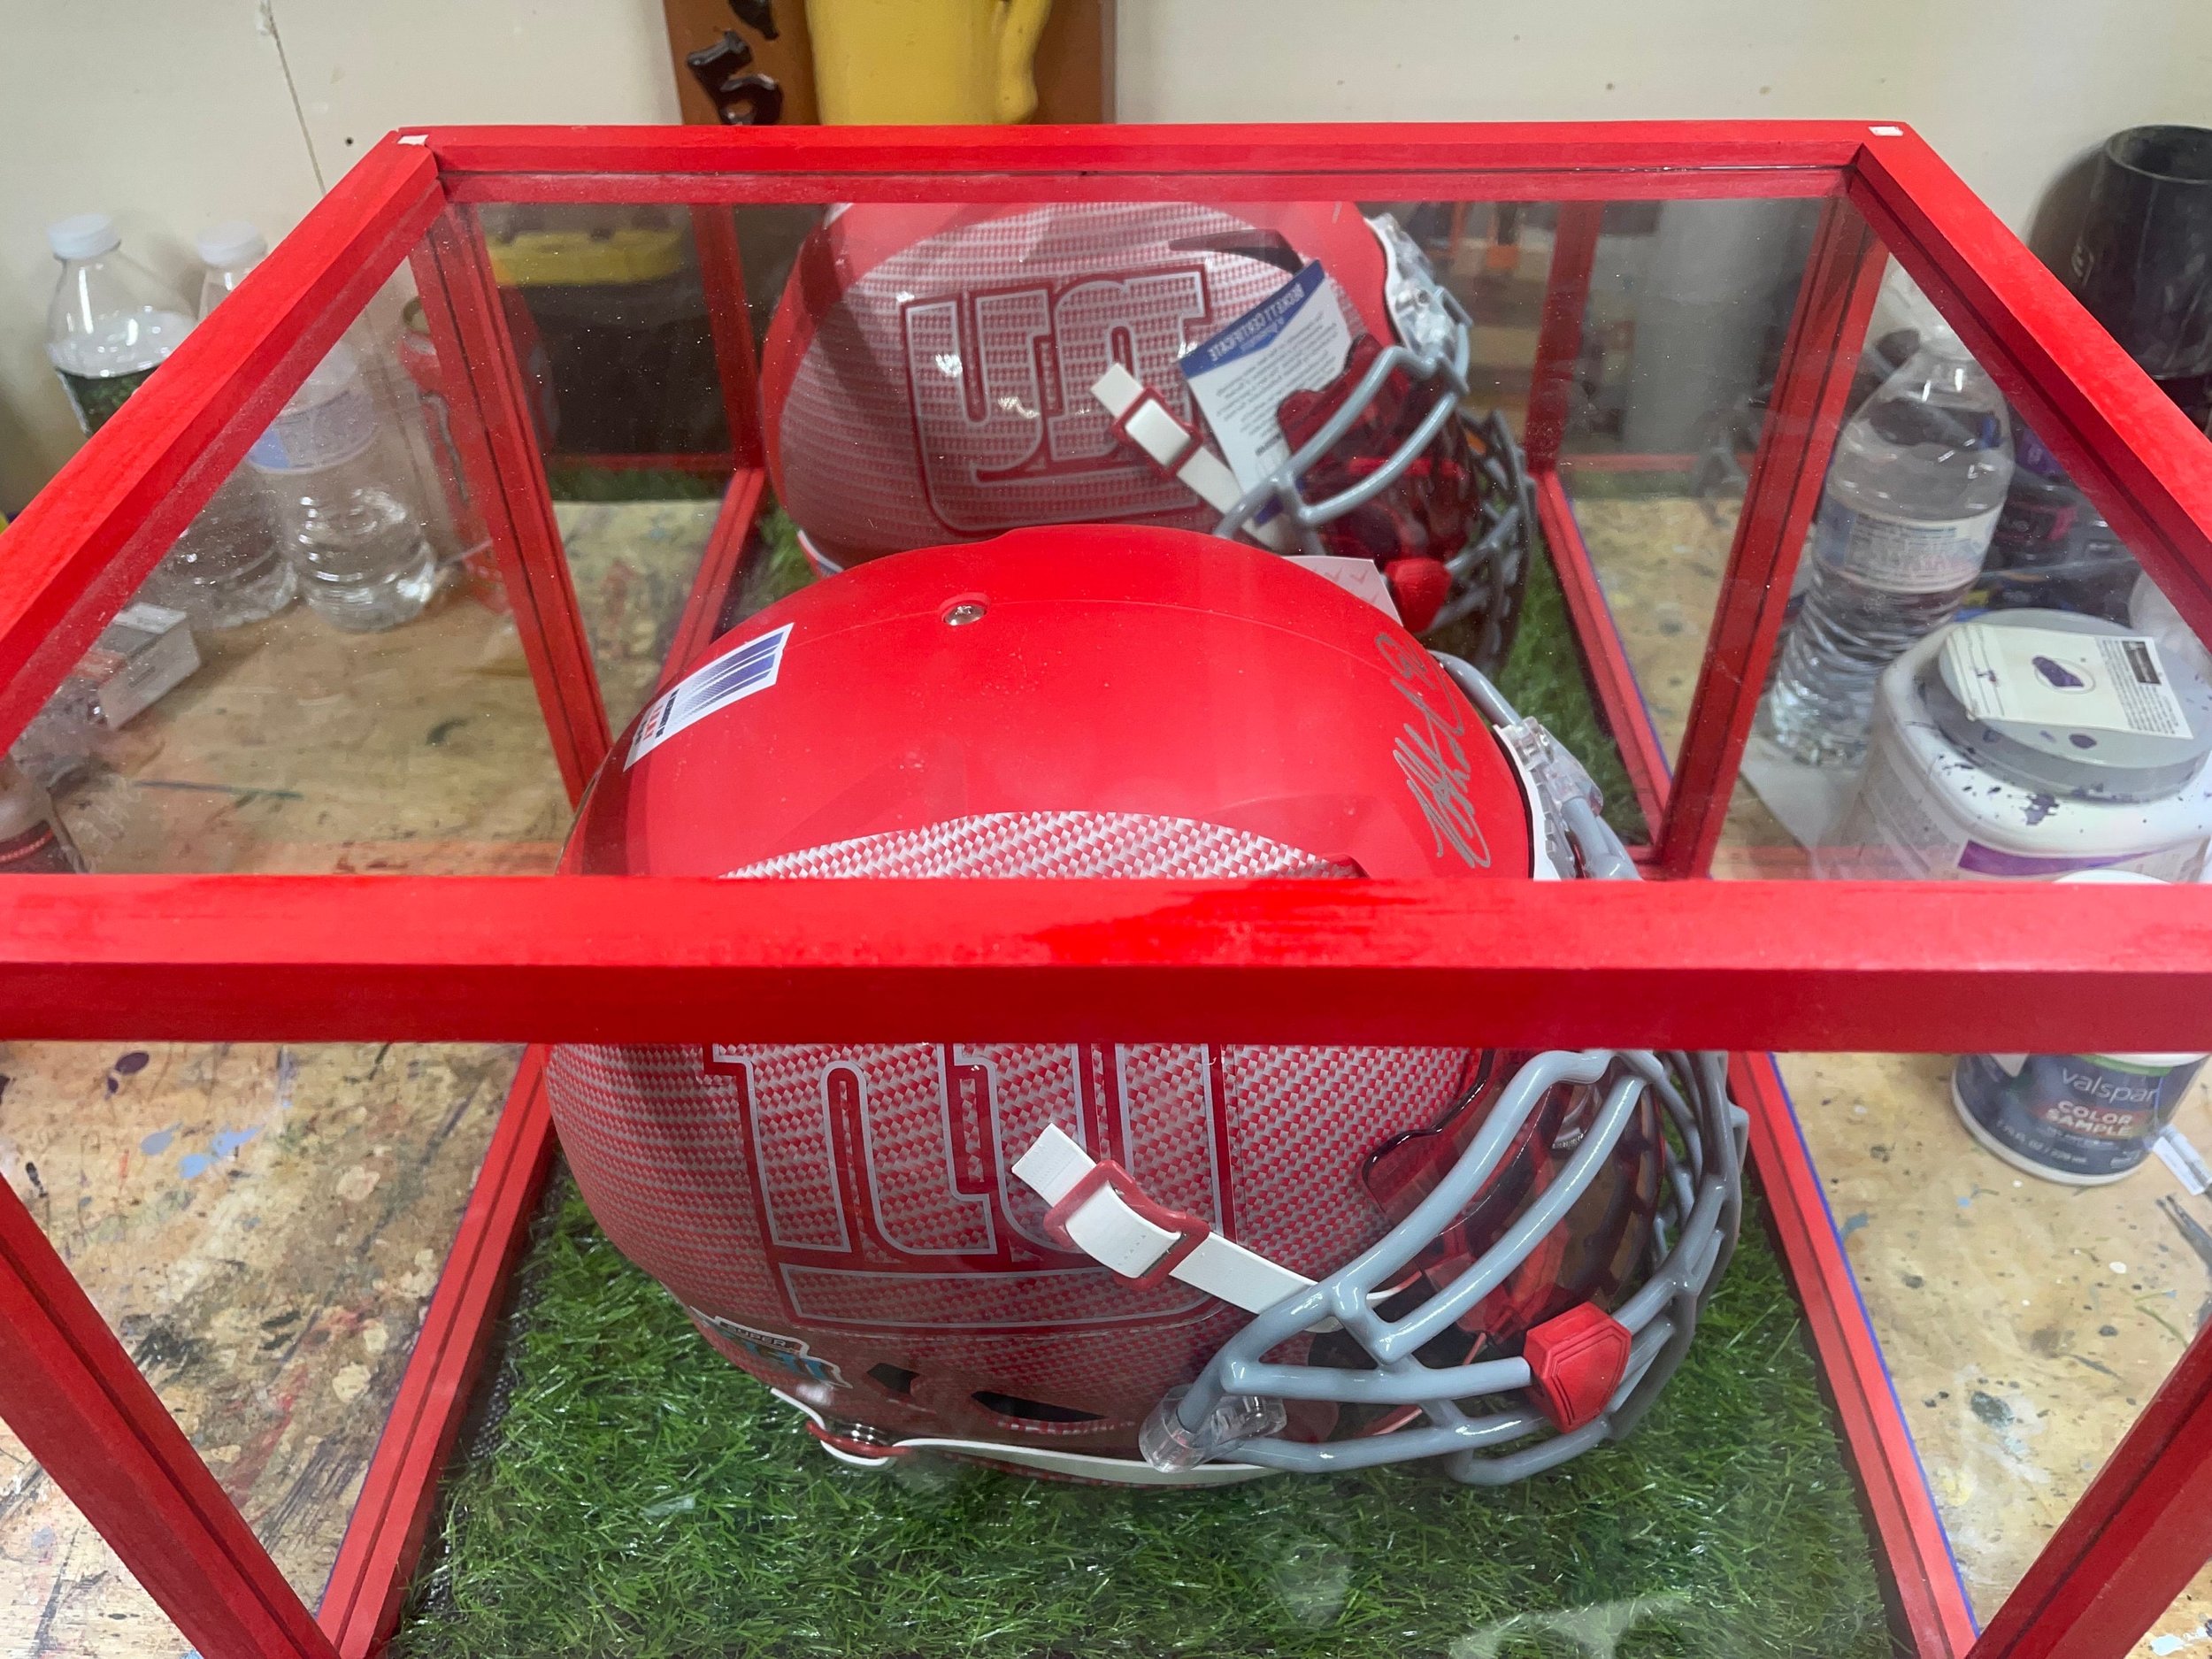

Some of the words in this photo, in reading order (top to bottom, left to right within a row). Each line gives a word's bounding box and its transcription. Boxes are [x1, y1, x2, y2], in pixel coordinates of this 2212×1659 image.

[2062, 1067, 2158, 1104] valspar
[2046, 1108, 2132, 1137] SAMPLE
[2057, 1100, 2133, 1125] COLOR
[726, 1325, 787, 1348] SUPER
